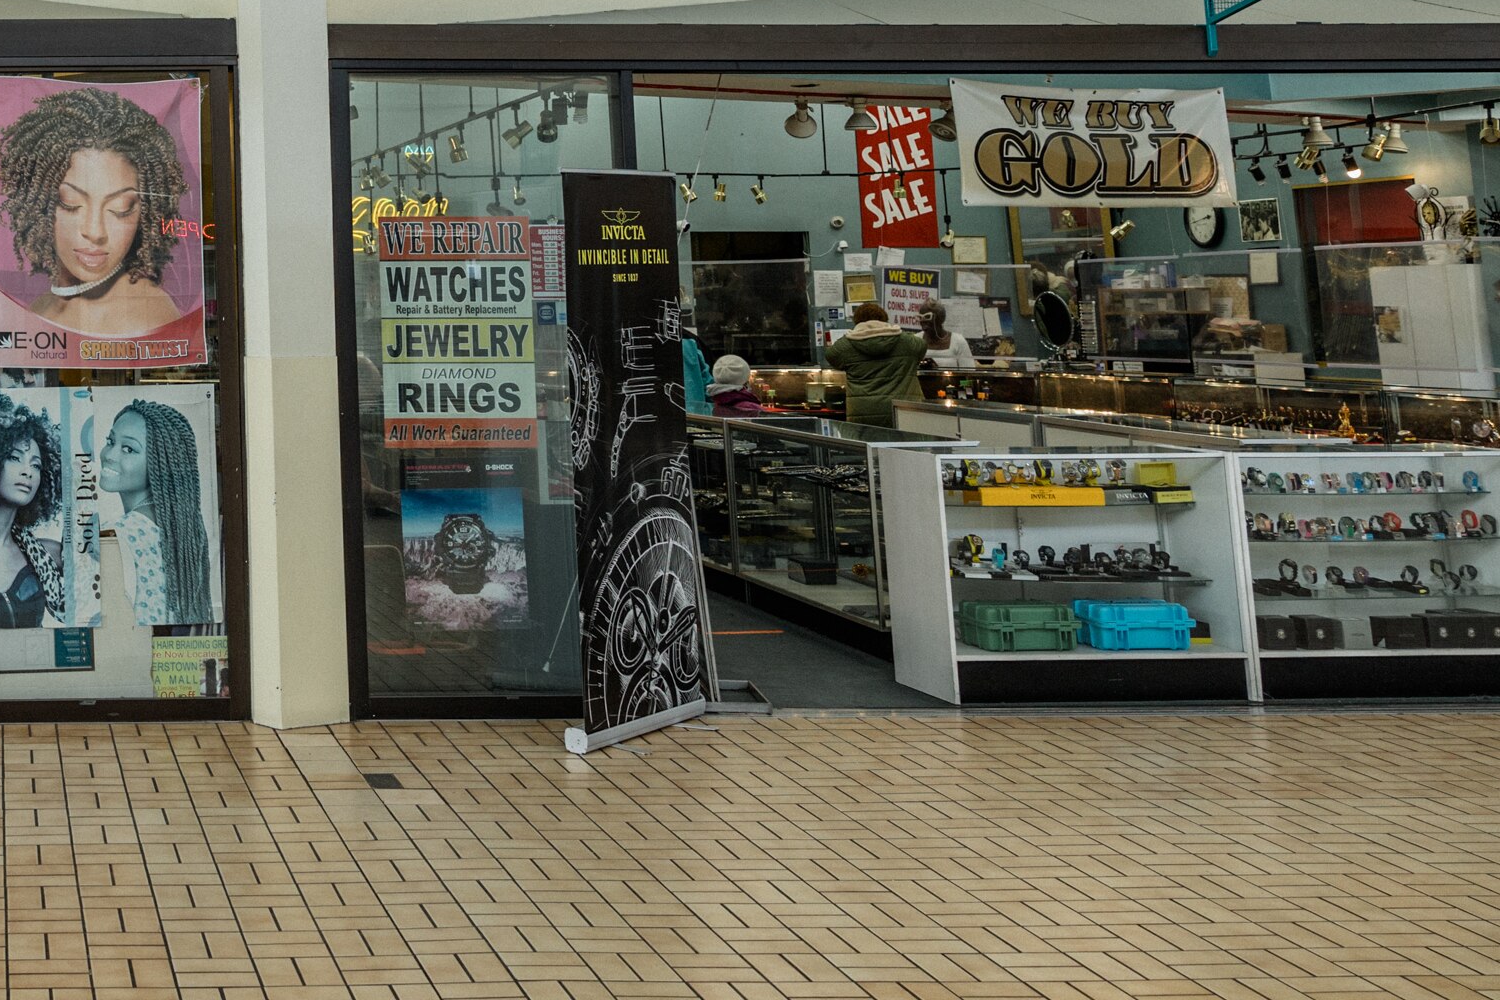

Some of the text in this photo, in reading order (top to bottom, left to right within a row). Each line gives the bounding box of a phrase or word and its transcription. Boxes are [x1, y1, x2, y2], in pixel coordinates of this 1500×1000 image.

[1001, 94, 1176, 132] WE BUY
[861, 132, 930, 181] SALE
[974, 127, 1220, 199] GOLD
[864, 179, 933, 229] SALE
[382, 222, 425, 255] WE
[430, 221, 526, 255] REPAIR
[601, 225, 646, 240] INVICTA
[578, 249, 669, 265] INVINCIBLE IN DETAIL
[385, 266, 526, 303] WATCHES
[612, 273, 627, 282] SINCE
[889, 270, 933, 285] WE BUY
[891, 288, 908, 299] GOLD,
[396, 305, 517, 316] Repair & Battery Replacement
[887, 301, 906, 312] COINS,
[386, 324, 529, 358] JEWELRY
[31, 350, 67, 359] Natural
[80, 339, 188, 360] SPRING TWIST
[422, 368, 496, 379] DIAMOND
[398, 382, 521, 413] RINGS
[389, 424, 531, 440] All Work Guaranteed
[1115, 491, 1149, 499] INVICTA
[74, 453, 94, 554] Soft Dred
[157, 640, 174, 649] HAIR
[176, 640, 210, 649] BRAIDING
[164, 650, 183, 658] Now
[187, 650, 222, 658] Located
[152, 662, 197, 671] ERSTOWN
[169, 675, 198, 684] MALL
